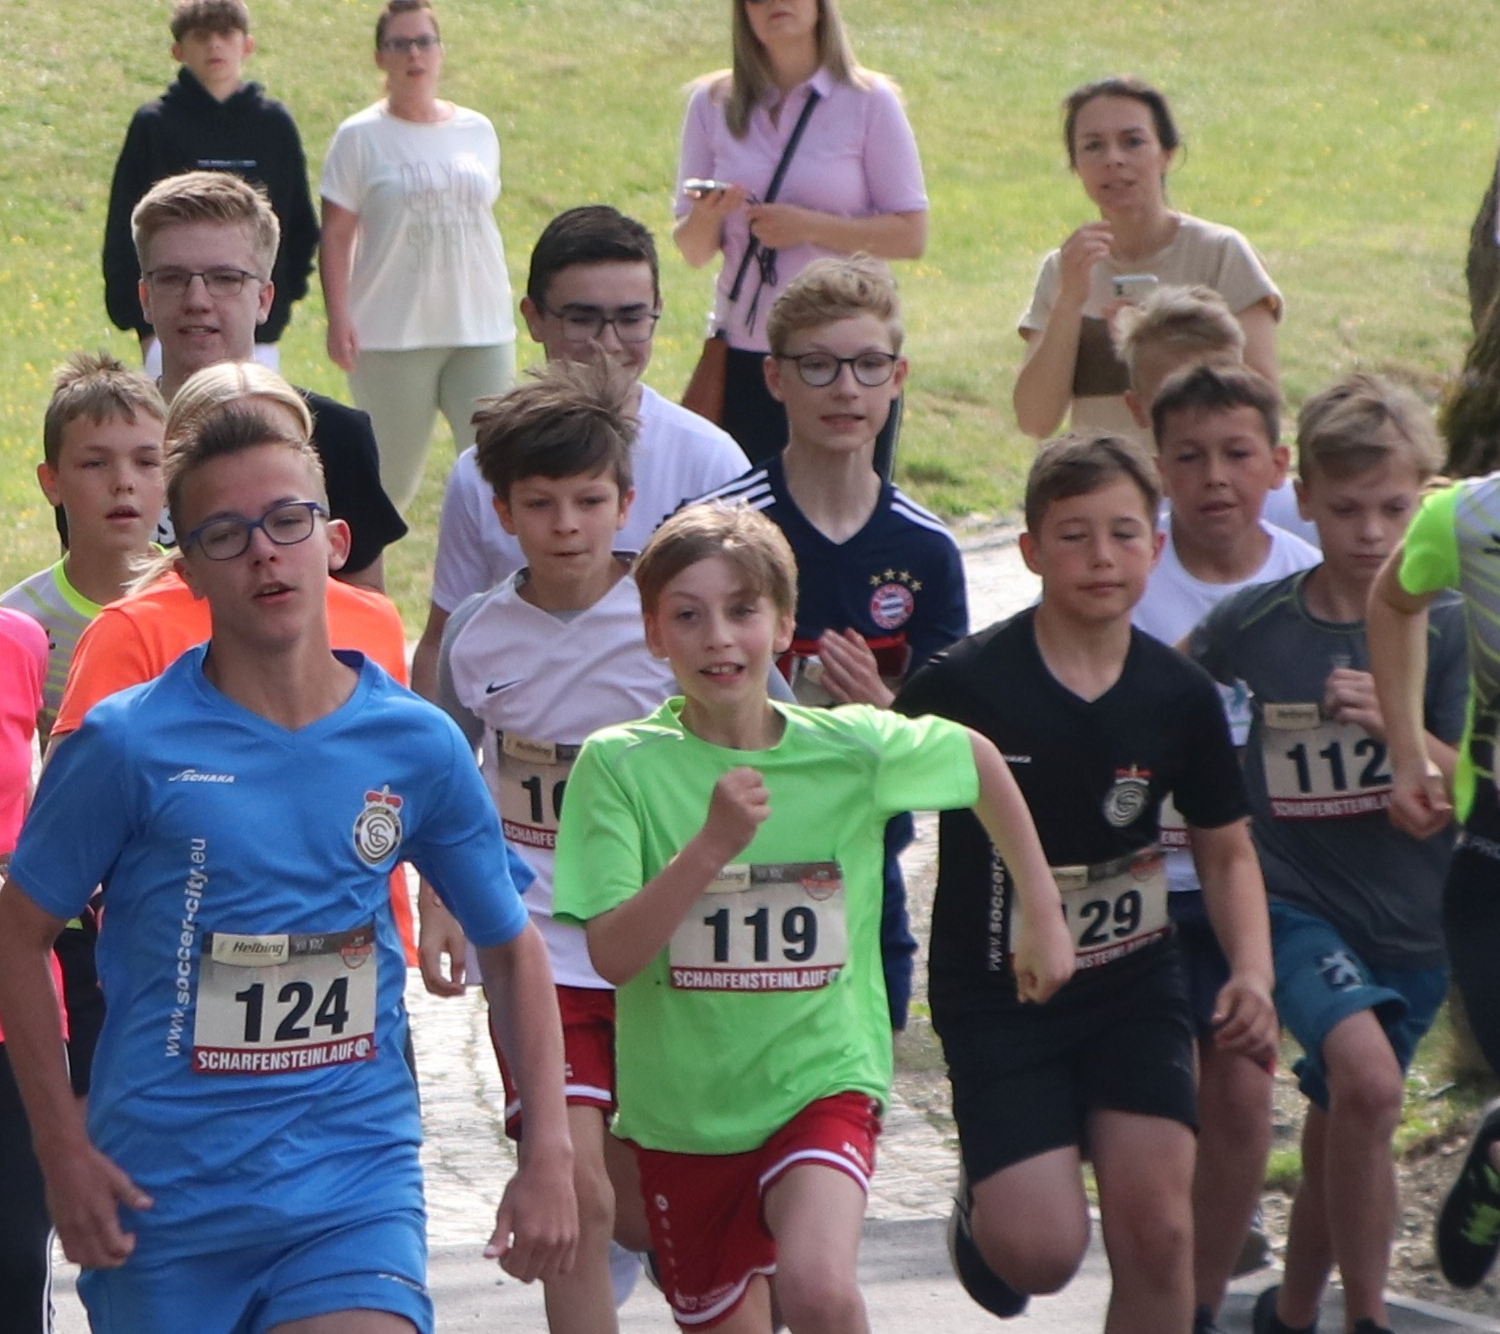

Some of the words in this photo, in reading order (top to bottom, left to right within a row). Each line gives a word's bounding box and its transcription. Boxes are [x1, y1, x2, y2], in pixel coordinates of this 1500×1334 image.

[1287, 738, 1392, 793] 112
[165, 838, 207, 1058] www.soccer-city.eu
[232, 941, 285, 957] Helbing
[704, 906, 817, 962] 119
[673, 970, 828, 988] SCHARFENSTEINLAUF
[235, 975, 349, 1043] 124
[197, 1041, 355, 1071] SCHARFENSTEINLAUF
